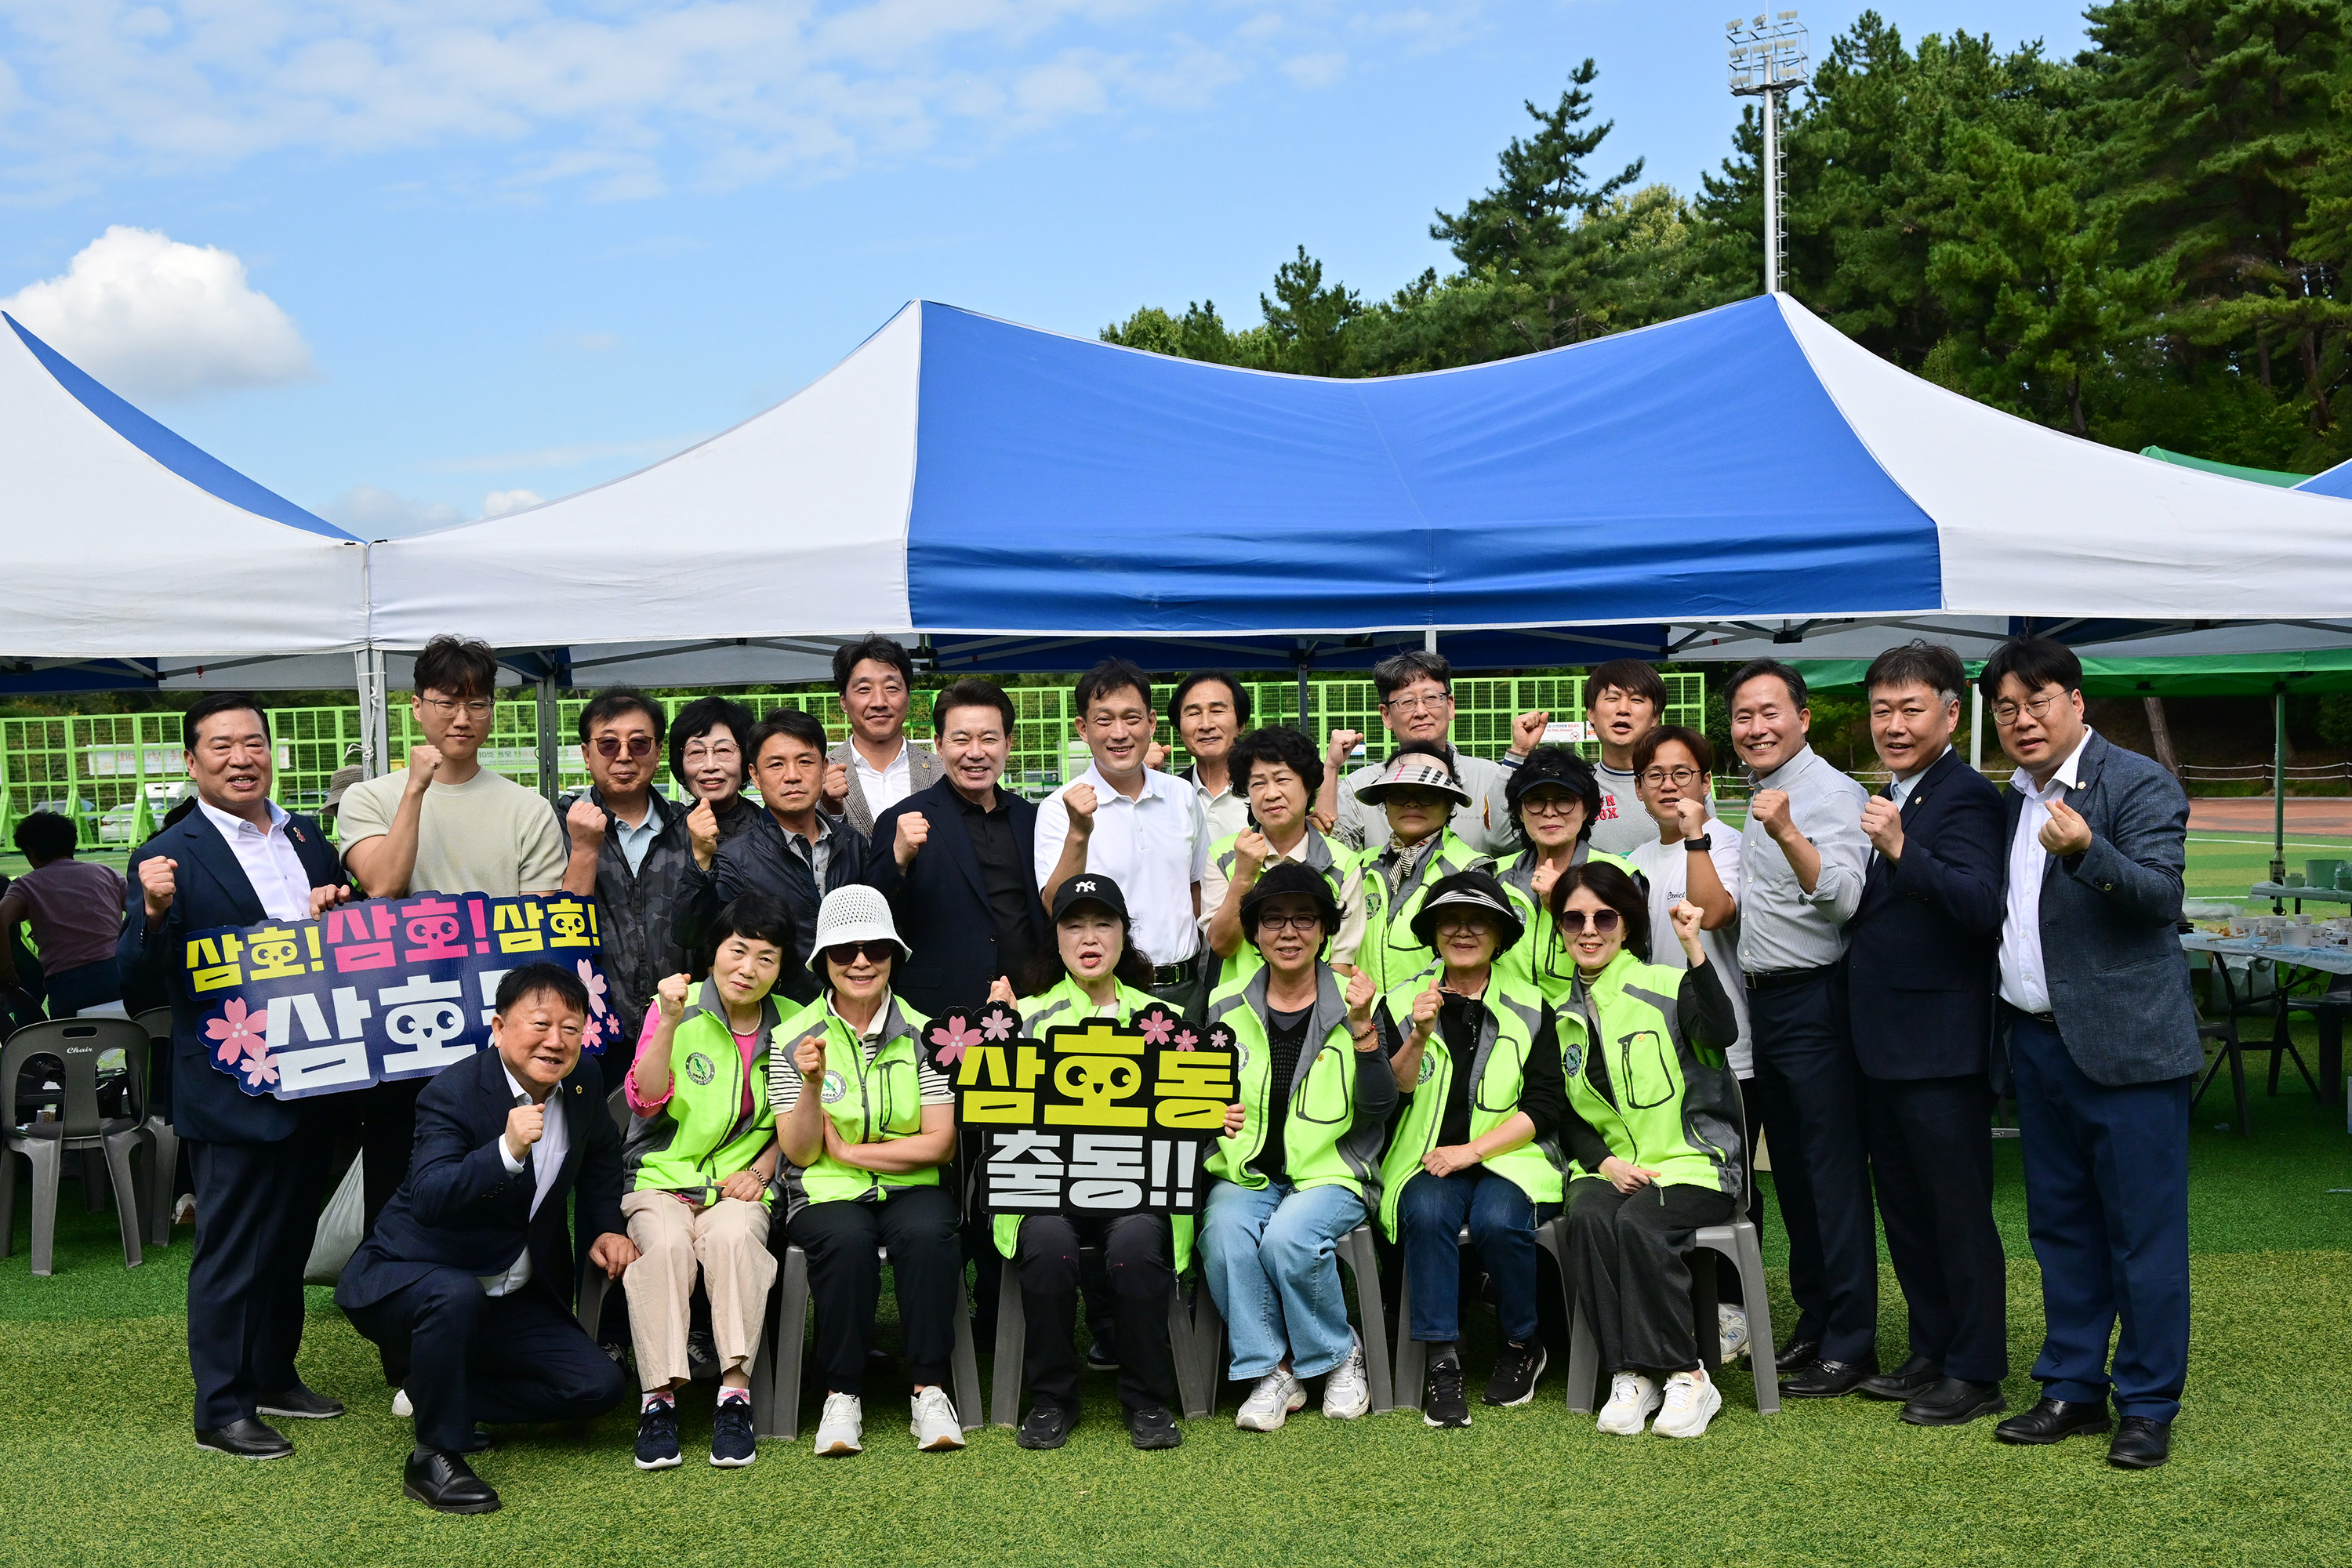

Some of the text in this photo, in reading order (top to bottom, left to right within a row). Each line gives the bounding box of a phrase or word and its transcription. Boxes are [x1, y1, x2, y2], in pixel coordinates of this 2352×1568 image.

[1595, 808, 1619, 821] OX
[1075, 880, 1096, 893] NY
[186, 898, 601, 993] 삼호! 삼호! 삼호!
[265, 969, 514, 1092] 삼호
[956, 1025, 1234, 1129] 삼호동
[987, 1130, 1198, 1209] 출동!!
